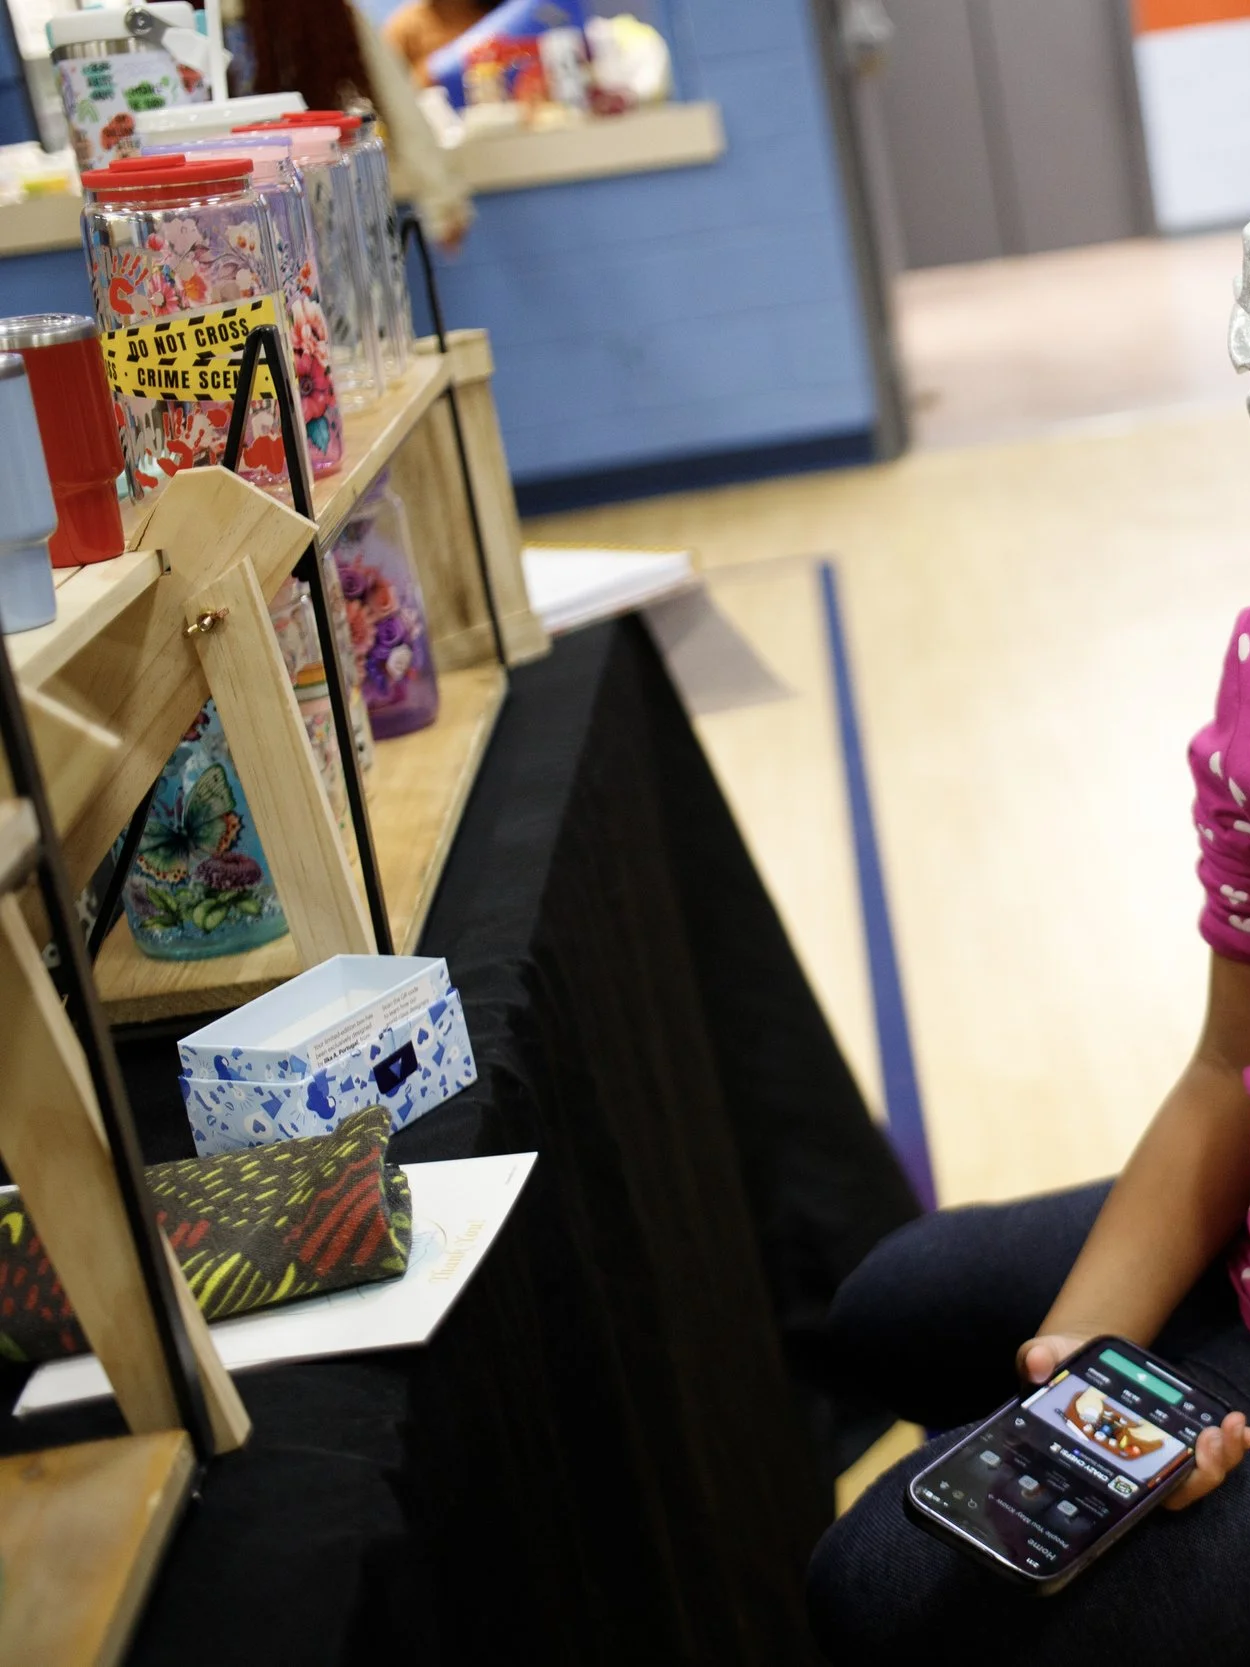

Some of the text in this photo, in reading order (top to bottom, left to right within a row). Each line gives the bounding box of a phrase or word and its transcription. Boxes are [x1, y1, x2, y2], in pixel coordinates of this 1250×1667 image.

[128, 317, 250, 359] DO NOT CROSS
[137, 366, 191, 390] CRIME
[1083, 1464, 1109, 1483] CRAZY
[996, 1498, 1069, 1549] People You May Know
[1027, 1538, 1057, 1561] Home
